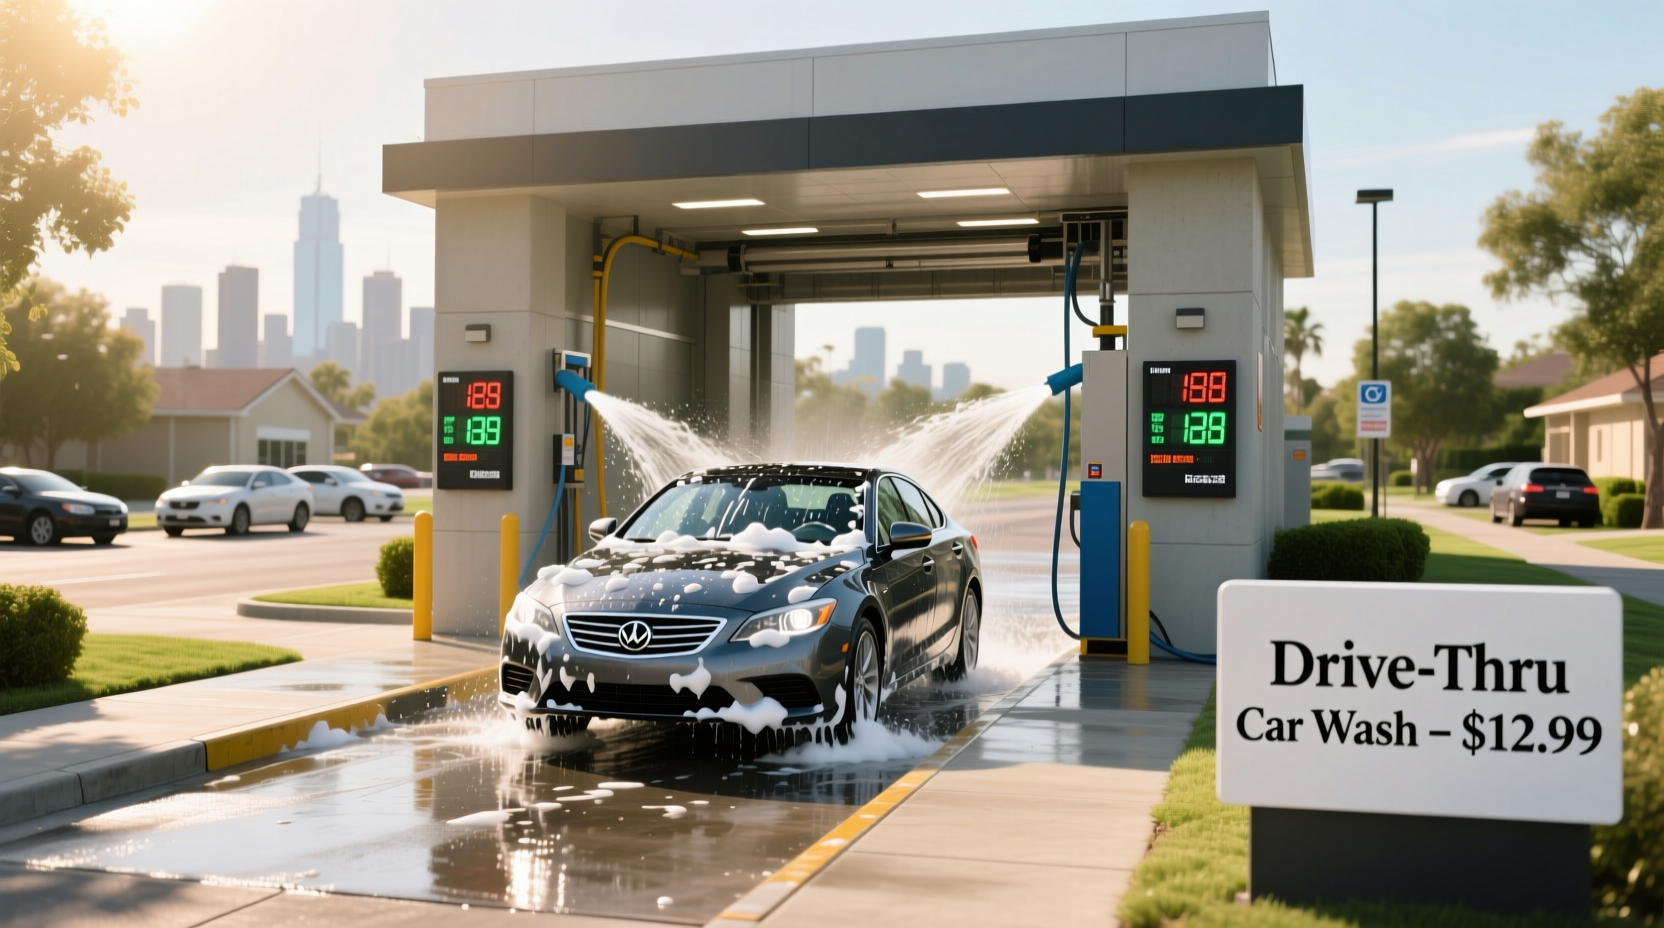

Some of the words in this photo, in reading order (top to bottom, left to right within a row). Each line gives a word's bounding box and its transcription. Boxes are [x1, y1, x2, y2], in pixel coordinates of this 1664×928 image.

[1270, 639, 1570, 695] Drive-Thru
[1236, 706, 1304, 742] Car
[1310, 709, 1419, 747] Wash
[1462, 708, 1603, 756] $12.99
